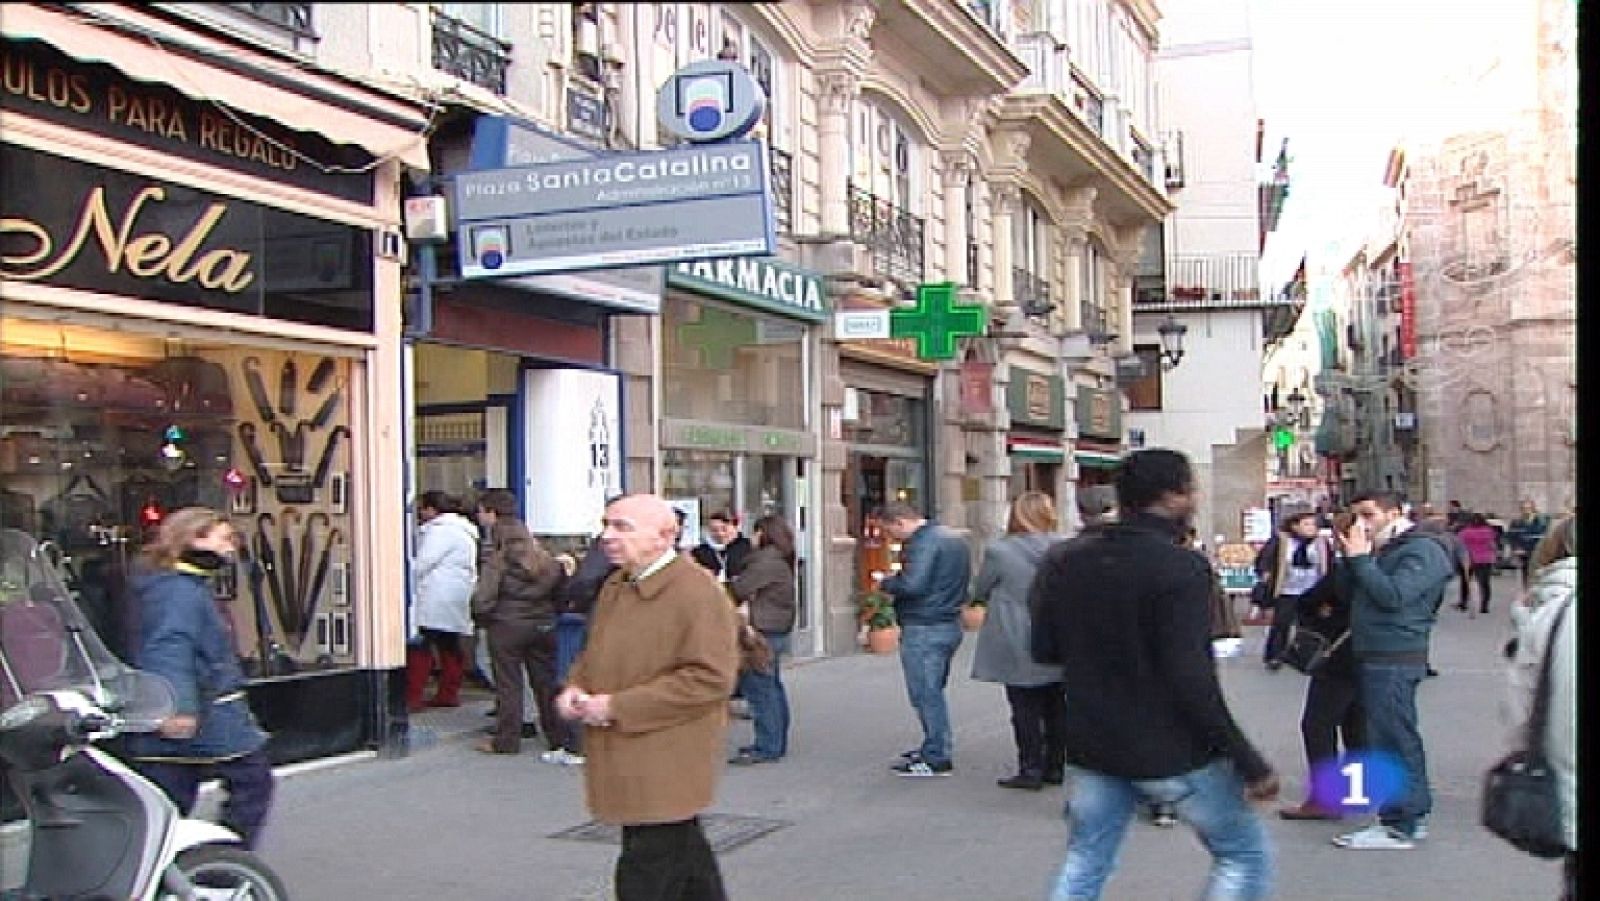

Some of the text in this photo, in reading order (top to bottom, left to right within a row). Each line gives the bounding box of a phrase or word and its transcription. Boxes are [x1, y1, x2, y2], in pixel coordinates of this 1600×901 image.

[0, 53, 298, 171] ULOS PARA REGALO
[465, 179, 521, 197] Plaza
[527, 151, 752, 193] SantaCatalina
[0, 186, 255, 293] Nela
